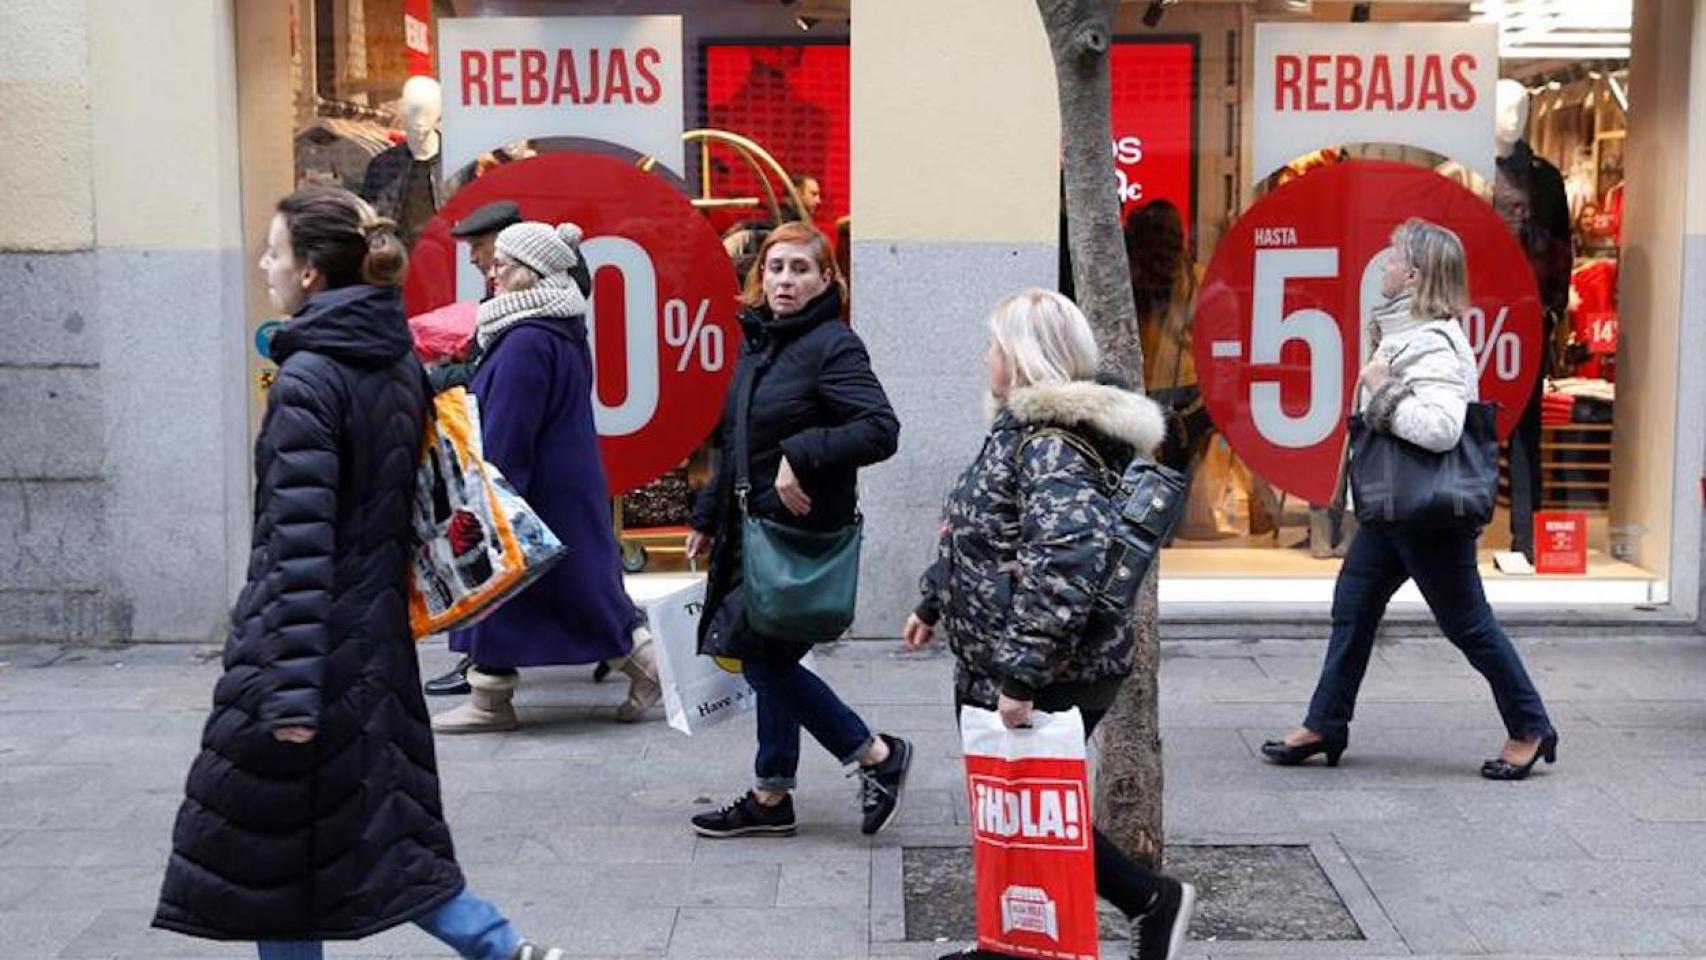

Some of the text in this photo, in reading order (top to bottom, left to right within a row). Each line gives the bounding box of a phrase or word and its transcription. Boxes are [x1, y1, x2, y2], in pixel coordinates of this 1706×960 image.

[461, 48, 661, 105] REBAJAS
[1275, 54, 1477, 111] REBAJAS
[1254, 227, 1297, 245] HASTA
[697, 697, 731, 717] Have
